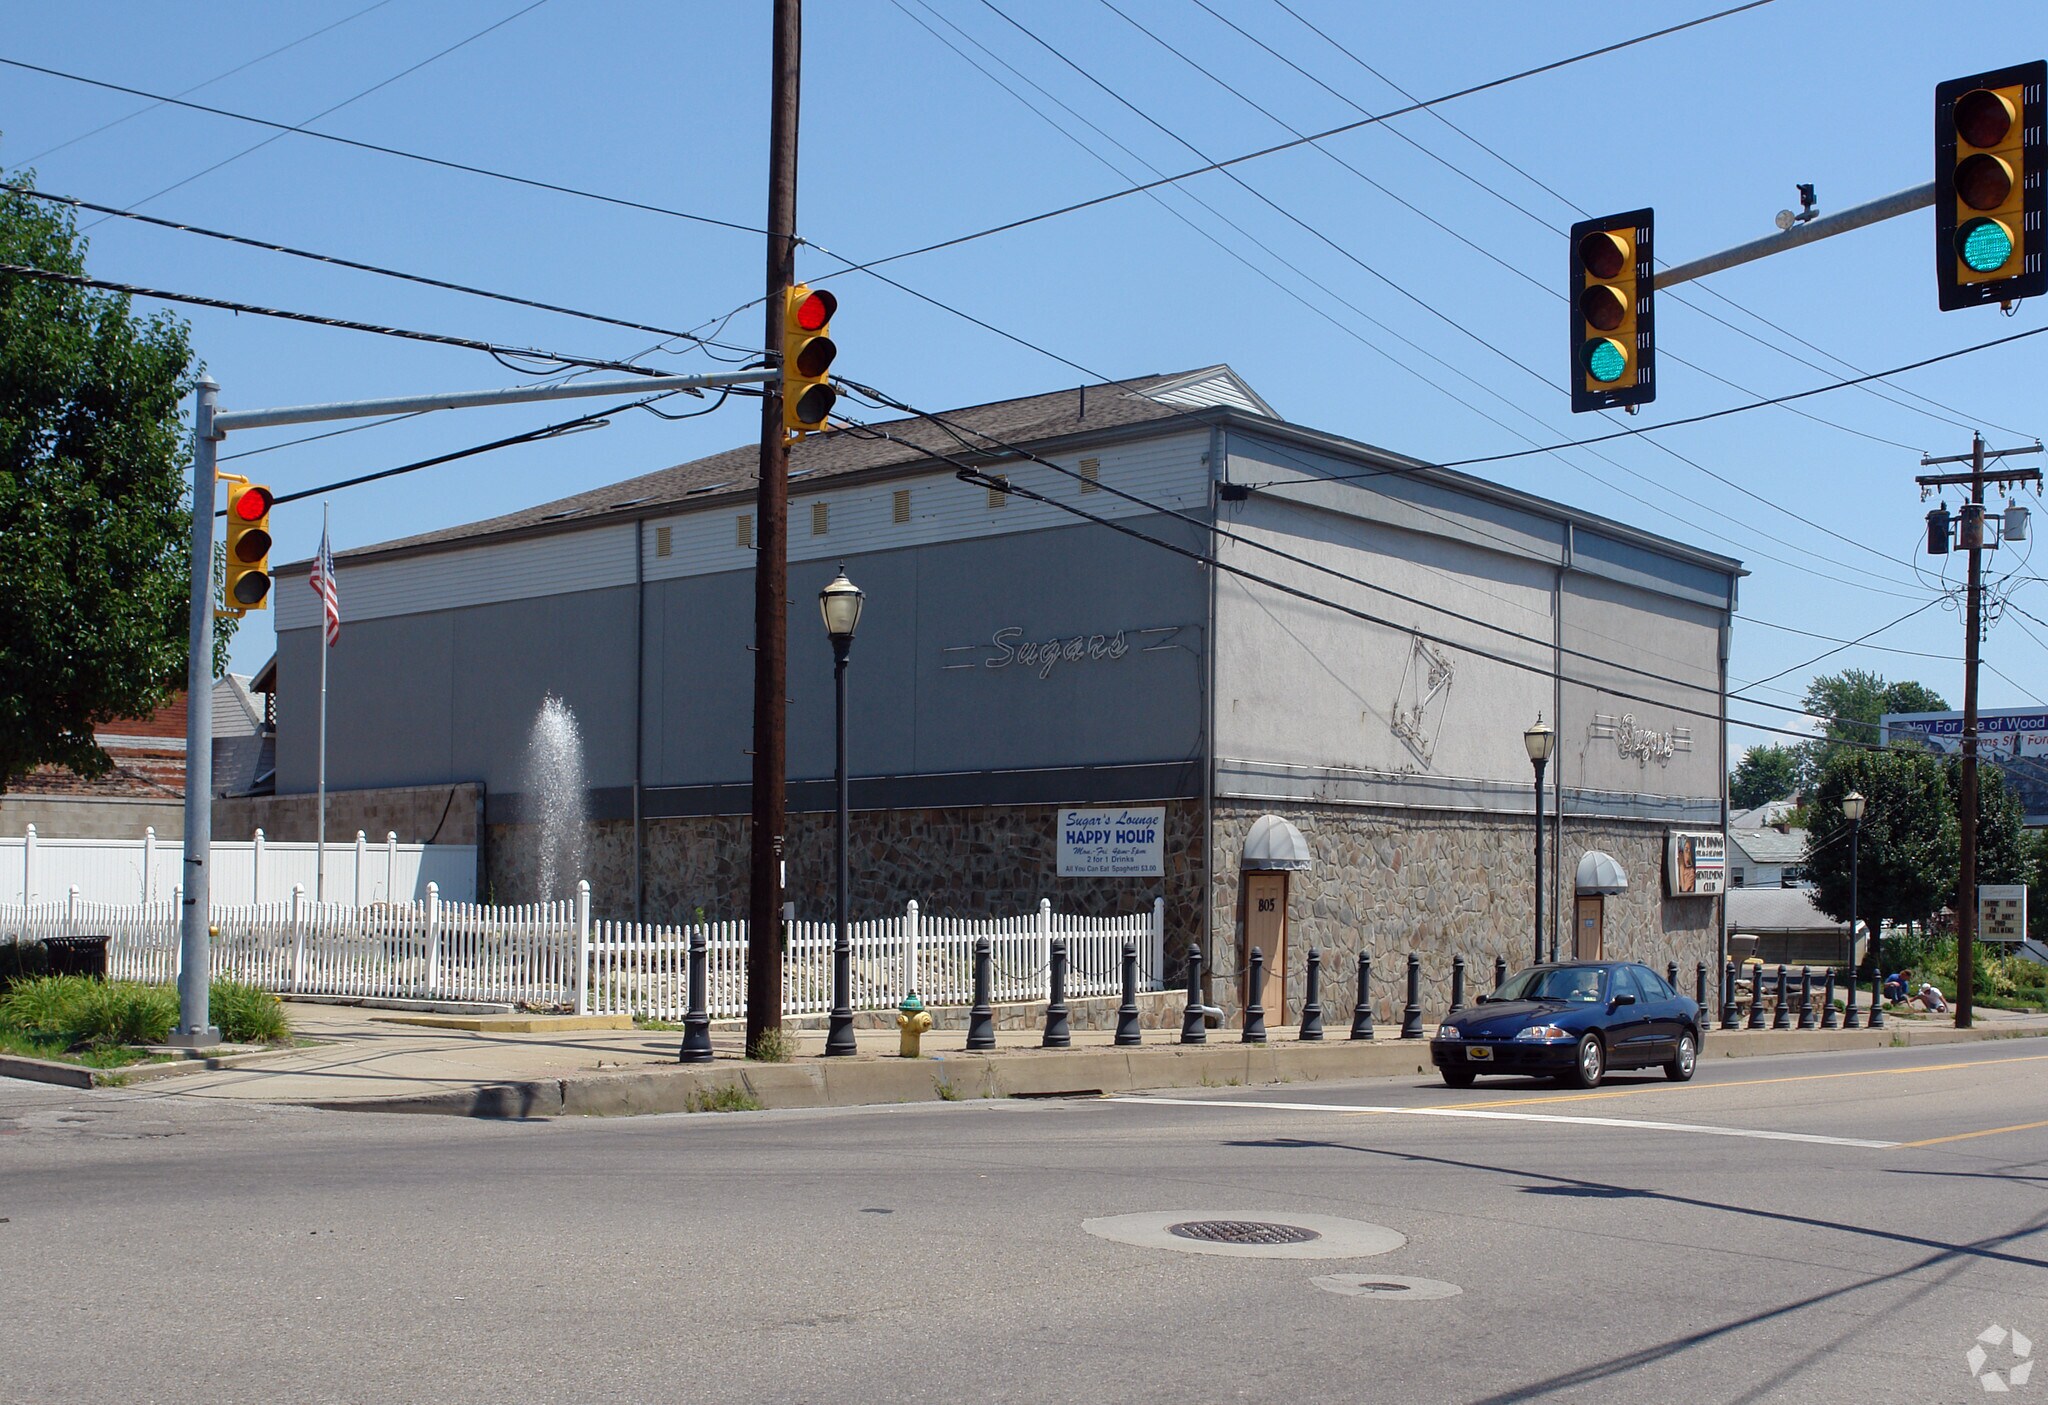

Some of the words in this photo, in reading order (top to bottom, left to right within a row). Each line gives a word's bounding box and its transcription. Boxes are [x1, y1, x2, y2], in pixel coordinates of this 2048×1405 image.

[1936, 721, 1958, 733] For
[1989, 718, 2003, 730] of
[2007, 716, 2046, 730] Wood
[1066, 812, 1111, 830] Sugar's
[1115, 810, 1159, 829] Lounge
[1066, 830, 1111, 844] HAPPY
[1115, 830, 1155, 844] HOUR
[1112, 865, 1139, 873] Spaghetti
[1258, 898, 1275, 912] 805
